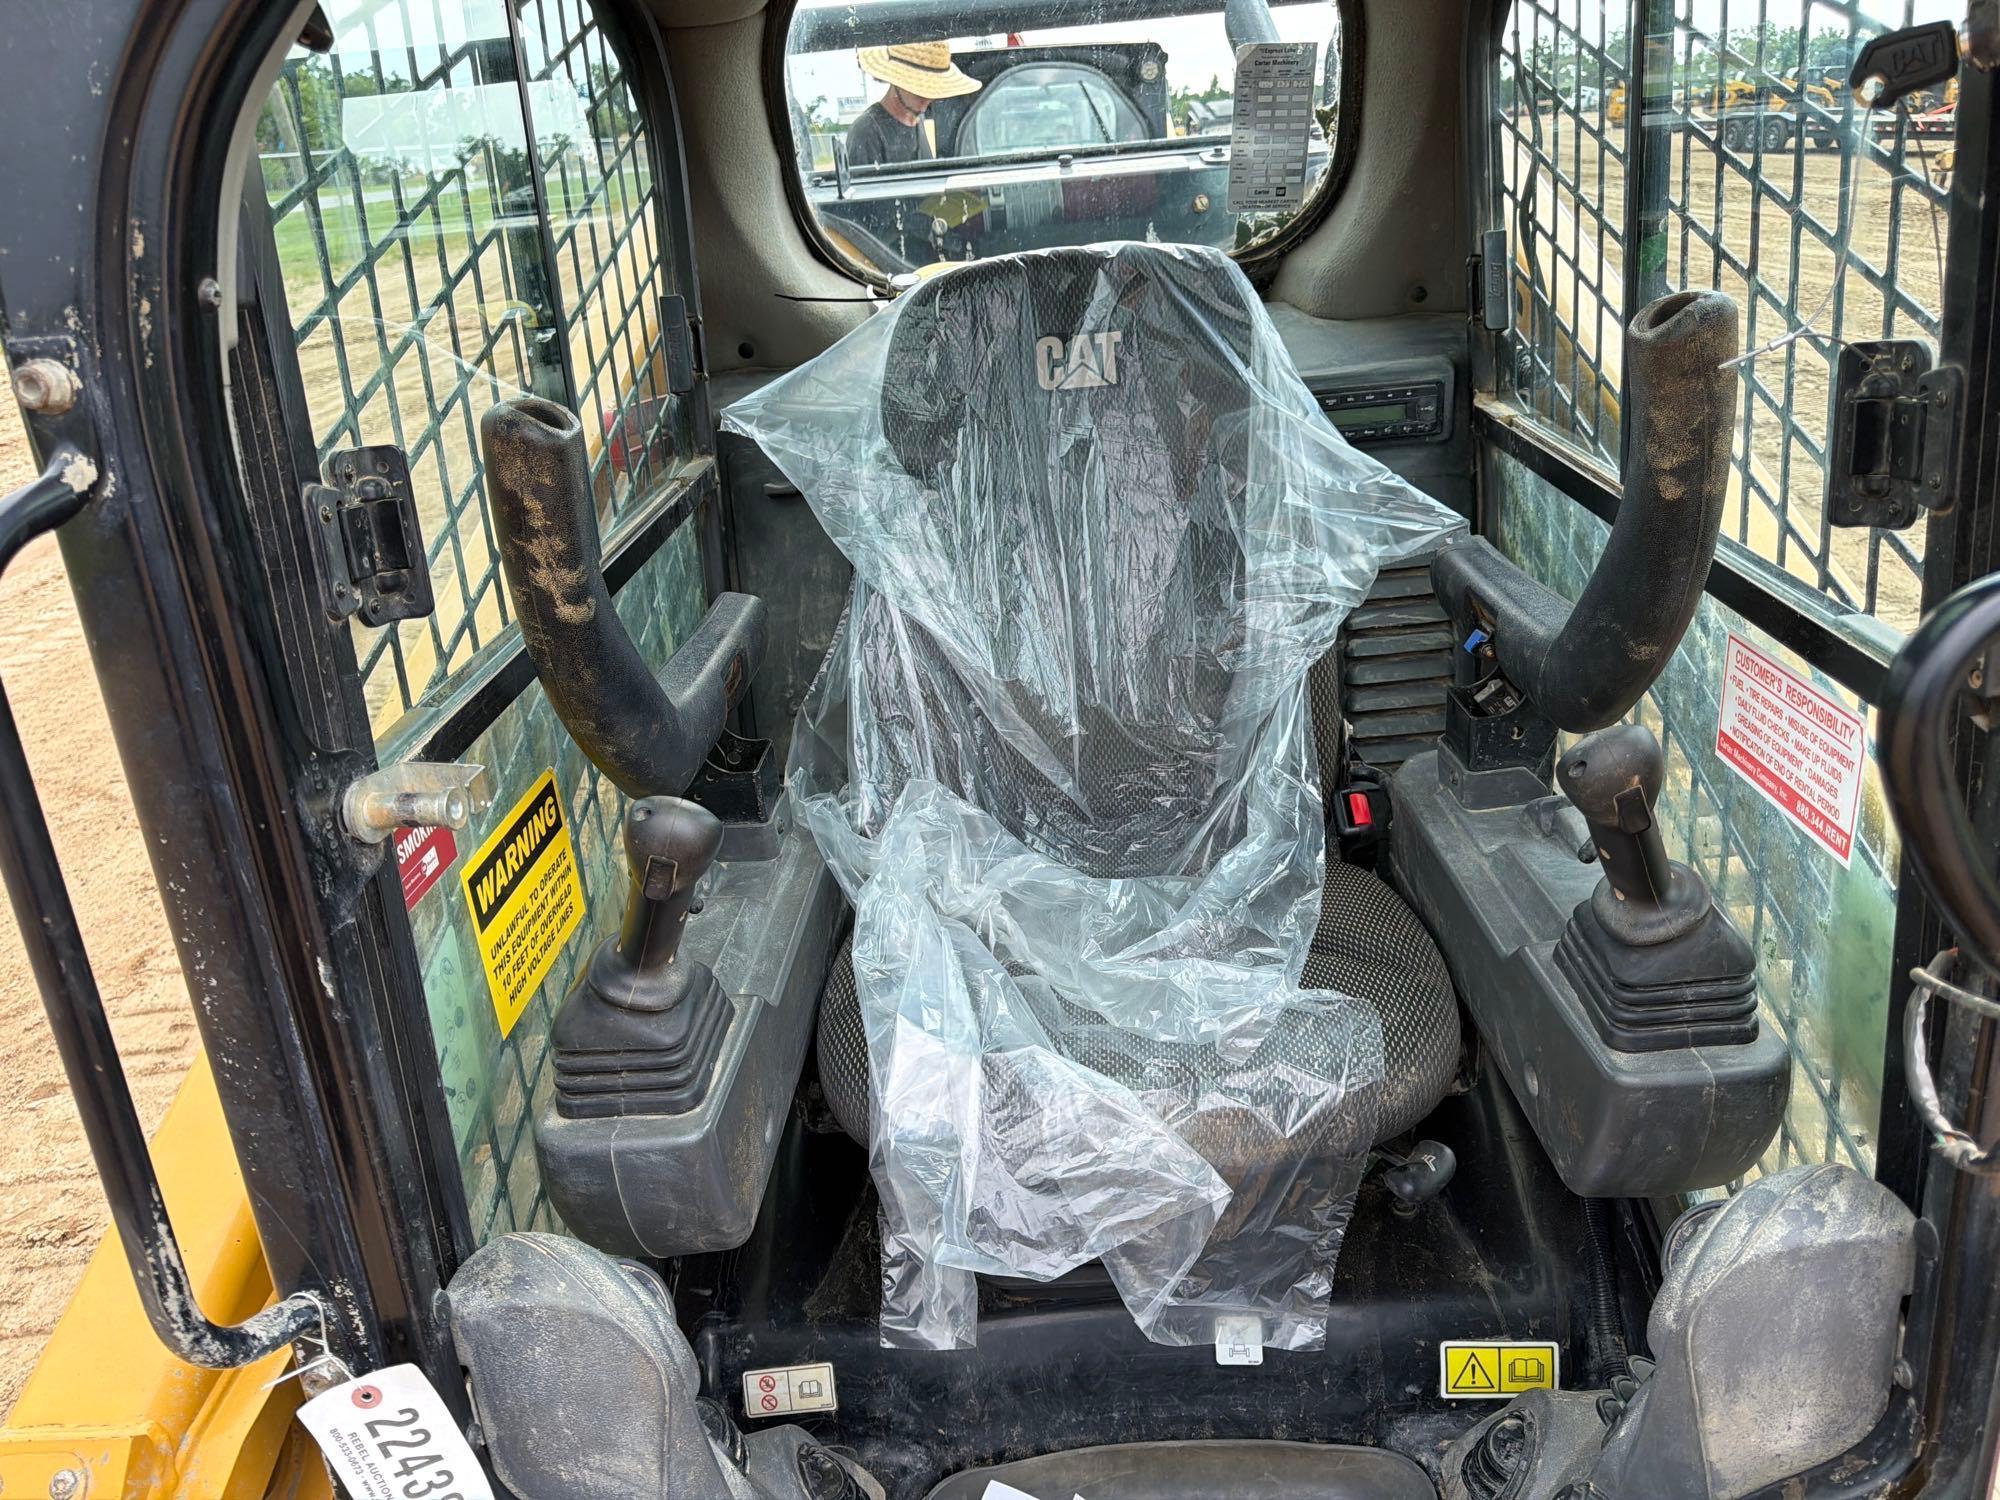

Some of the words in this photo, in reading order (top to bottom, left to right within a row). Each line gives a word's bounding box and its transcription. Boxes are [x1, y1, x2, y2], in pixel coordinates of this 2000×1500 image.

[1891, 37, 1939, 77] CAT
[1035, 331, 1121, 391] CAT
[1732, 674, 1744, 692] FUEL
[1749, 686, 1761, 704] TIRE
[1761, 695, 1783, 720] REPAIRS
[1787, 715, 1809, 740] MISUSE
[1809, 732, 1818, 746] OF
[1818, 739, 1855, 773] EQUIPMENT
[1735, 649, 1783, 694] CUSTOMER'S
[1785, 682, 1856, 742] RESPONSIBILITY
[1737, 695, 1752, 713] DAILY
[1752, 706, 1767, 726] FLUID
[1767, 718, 1790, 743] CHECKS
[1793, 738, 1812, 760] MAKE
[1811, 750, 1821, 765] UP
[1820, 758, 1842, 783] FLUIDS
[1719, 737, 1734, 755] Carter
[1732, 748, 1757, 776] Machinery
[1755, 763, 1778, 796] Company,
[1778, 786, 1789, 802] Inc.
[1794, 799, 1848, 852] 888.344.RENT
[1732, 725, 1765, 760] NOTIFICATION
[1765, 751, 1775, 765] OF
[1774, 758, 1785, 776] END
[1785, 768, 1795, 782] OF
[1794, 776, 1817, 803] RENTAL
[1816, 794, 1840, 820] PERIOD
[1737, 712, 1763, 741] GREASING
[1763, 733, 1772, 744] OF
[1771, 738, 1803, 772] EQUIPMENT
[1807, 767, 1839, 800] DAMAGES
[396, 825, 438, 865] SMOKI
[475, 796, 557, 915] WARNING
[490, 902, 529, 960] UNLAWFUL
[529, 887, 539, 906] TO
[539, 848, 567, 892] OPERATE
[493, 950, 511, 980] THIS
[511, 893, 549, 954] EQUIPMENT
[549, 862, 572, 898] WITHIN
[502, 973, 512, 991] 10
[512, 946, 529, 979] FEET
[530, 931, 540, 950] OF
[540, 883, 572, 936] OVERHEAD
[508, 972, 528, 1007] HIGH
[527, 928, 556, 976] VOLTAGE
[556, 901, 574, 935] LINES
[329, 1427, 364, 1476] 800-533-0673
[347, 1431, 370, 1461] REBEL
